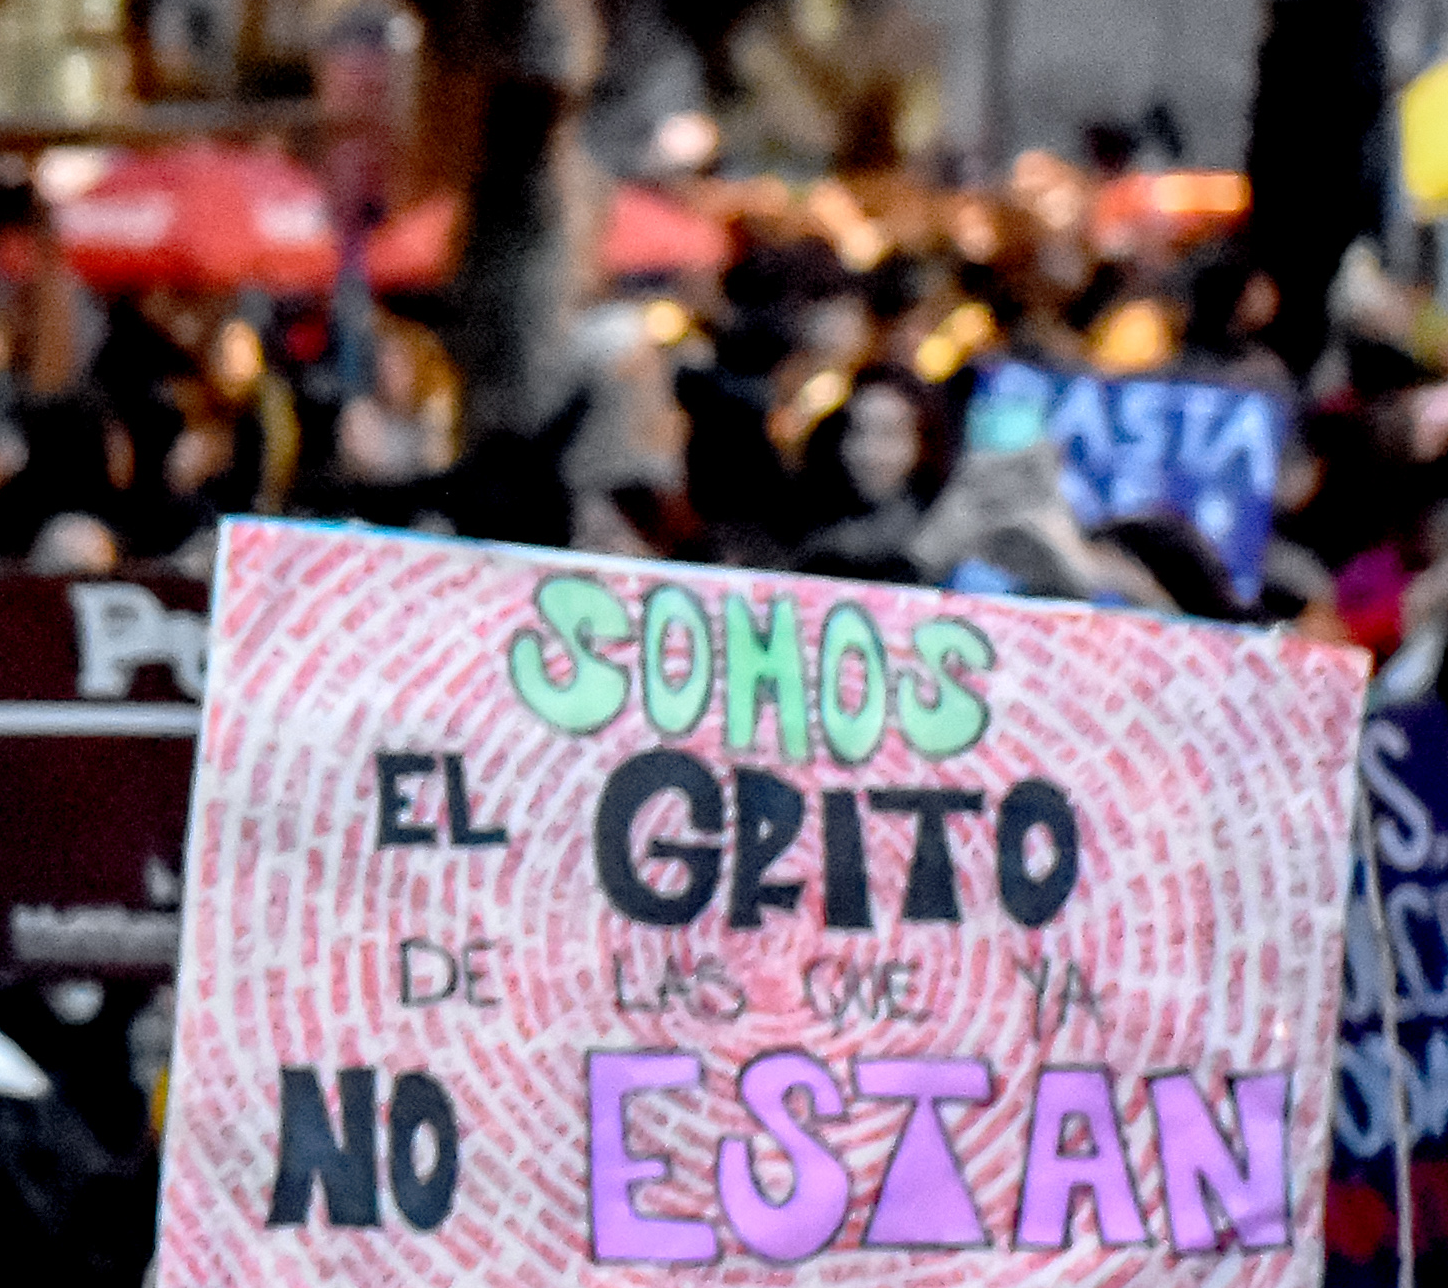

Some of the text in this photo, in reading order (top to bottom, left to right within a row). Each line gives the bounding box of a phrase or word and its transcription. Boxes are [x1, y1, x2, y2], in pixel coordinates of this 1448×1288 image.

[508, 572, 997, 764] SOMOS
[375, 748, 1080, 930] EL GRITO
[398, 936, 1103, 1041] DE LAS QUE YA
[264, 1062, 461, 1235] NO
[585, 1044, 1295, 1267] ESTAN
